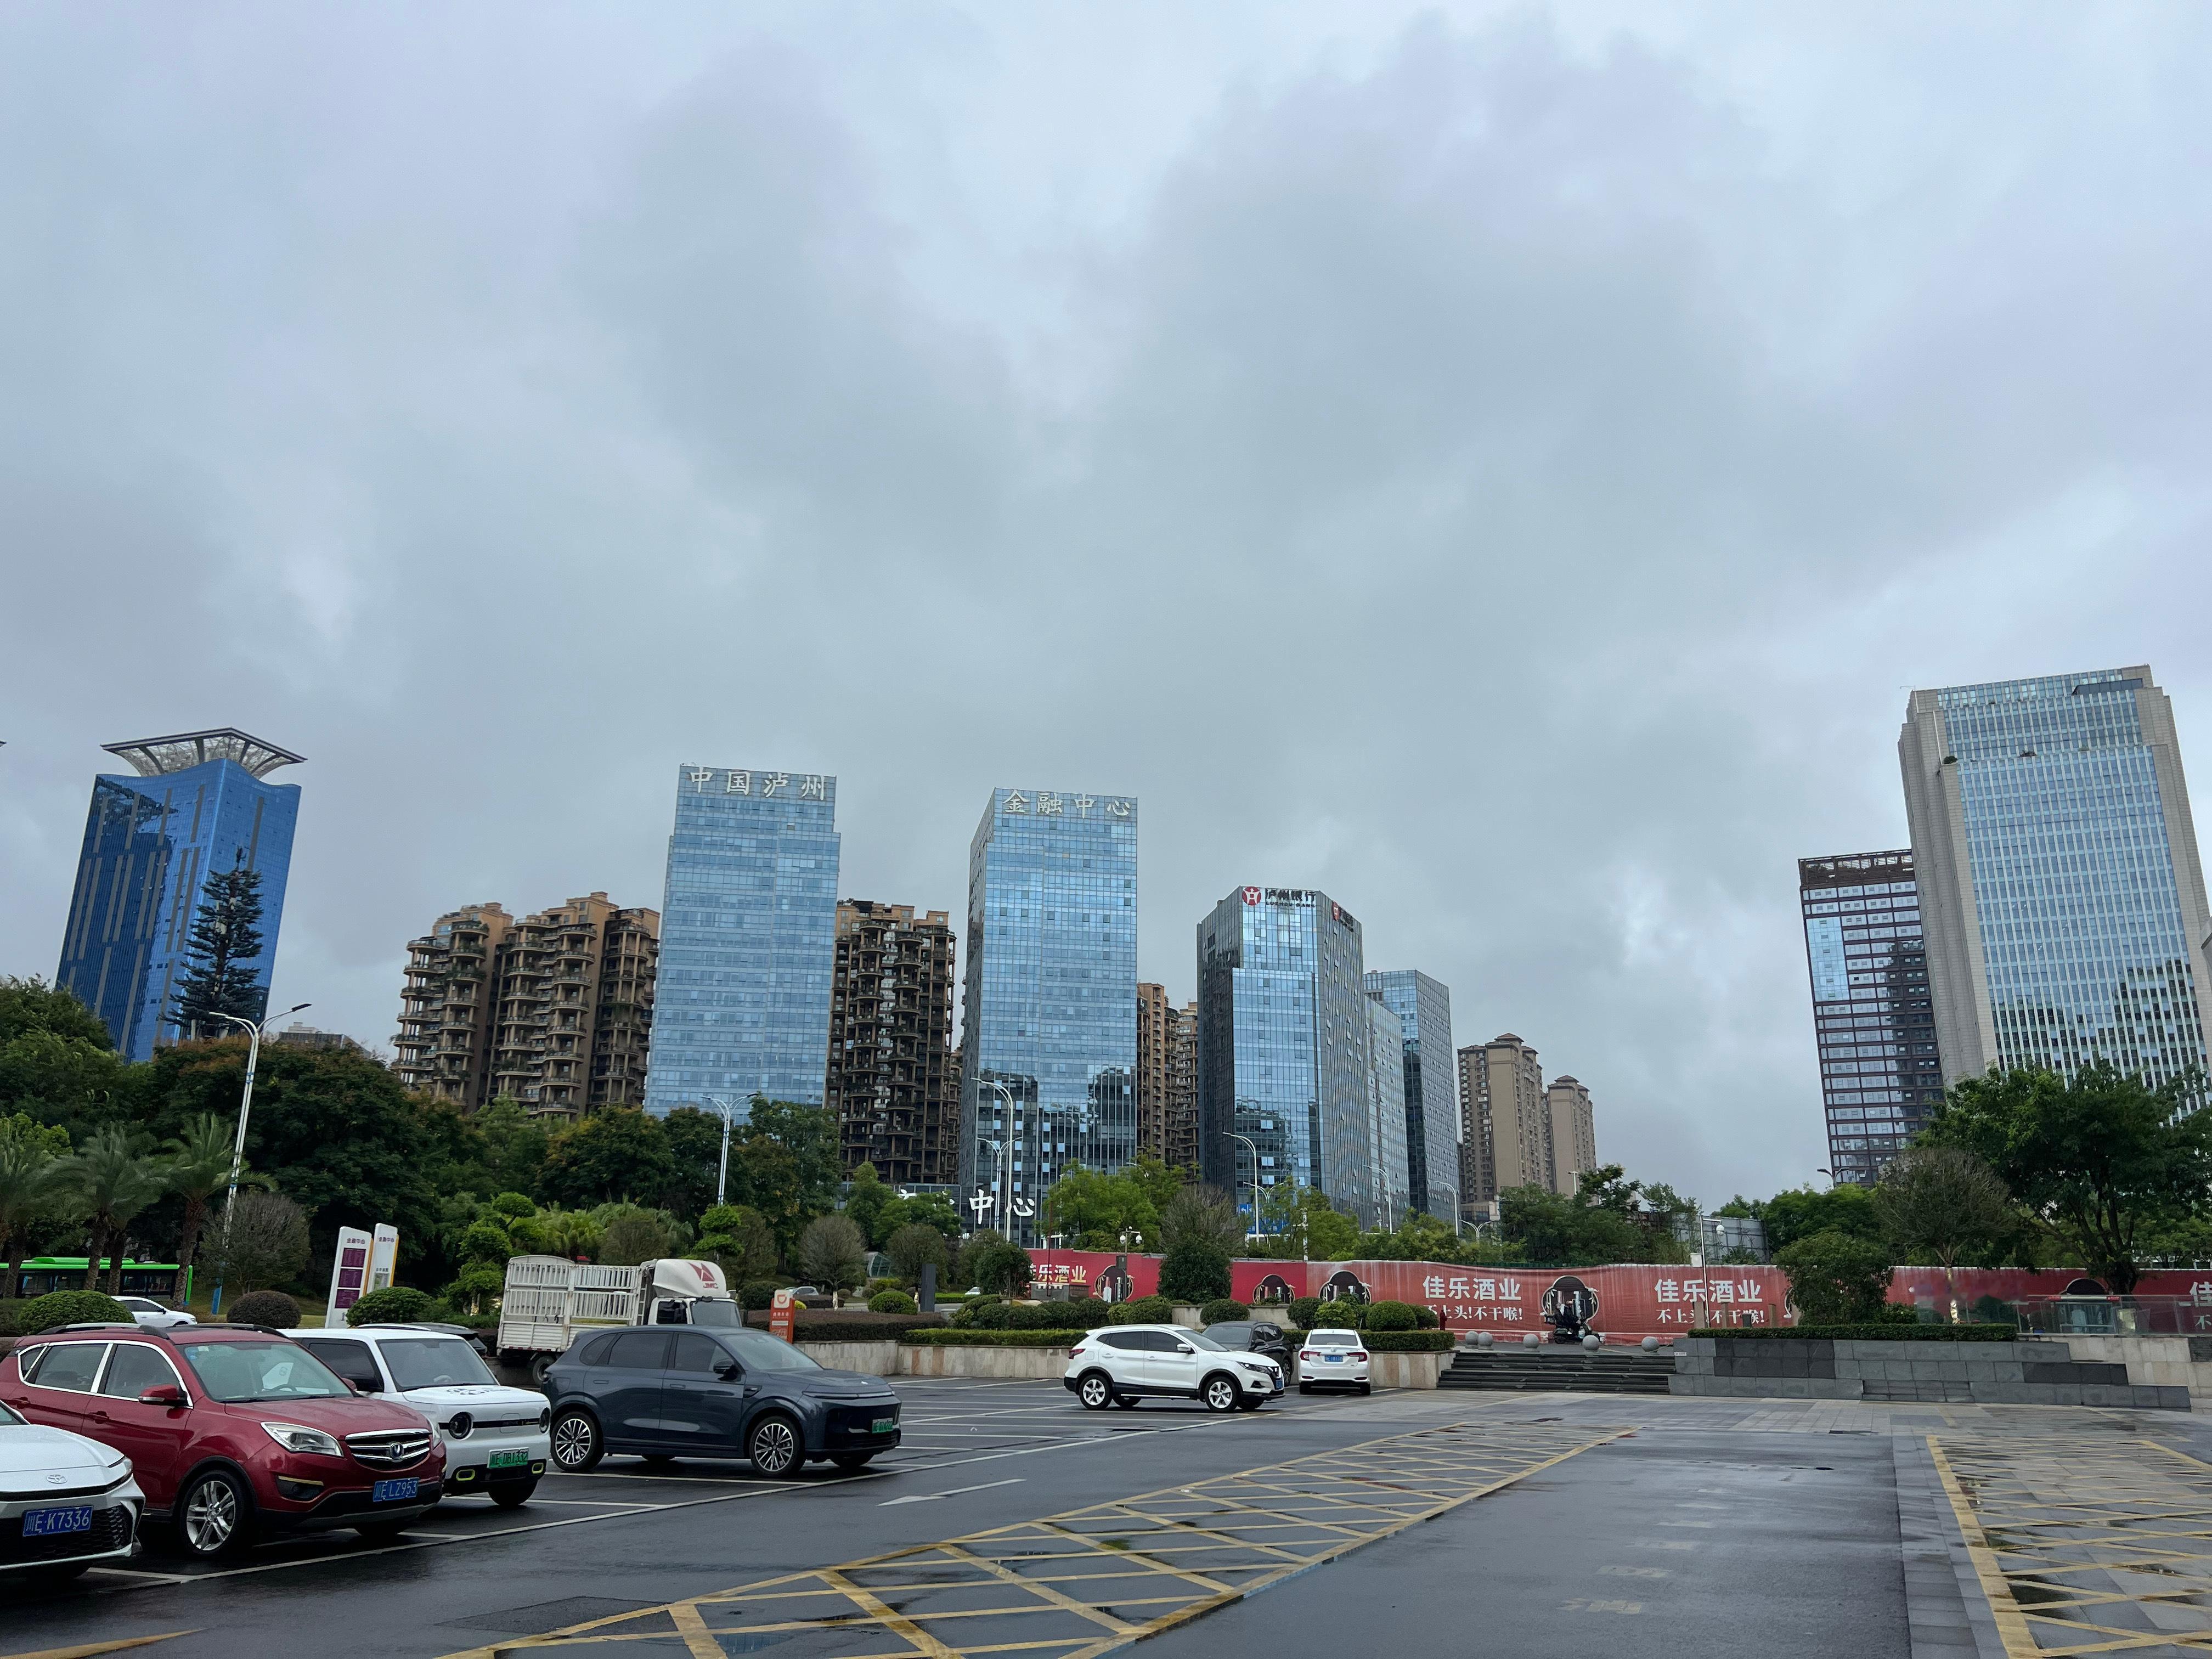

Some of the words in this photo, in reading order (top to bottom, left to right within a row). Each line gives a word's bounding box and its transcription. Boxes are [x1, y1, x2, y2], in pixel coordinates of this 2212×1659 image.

[690, 766, 825, 801] 中国泸州
[1002, 789, 1130, 819] 金融中心
[1423, 1276, 1521, 1301] 佳乐酒业
[1654, 1279, 1763, 1303] 佳乐酒业
